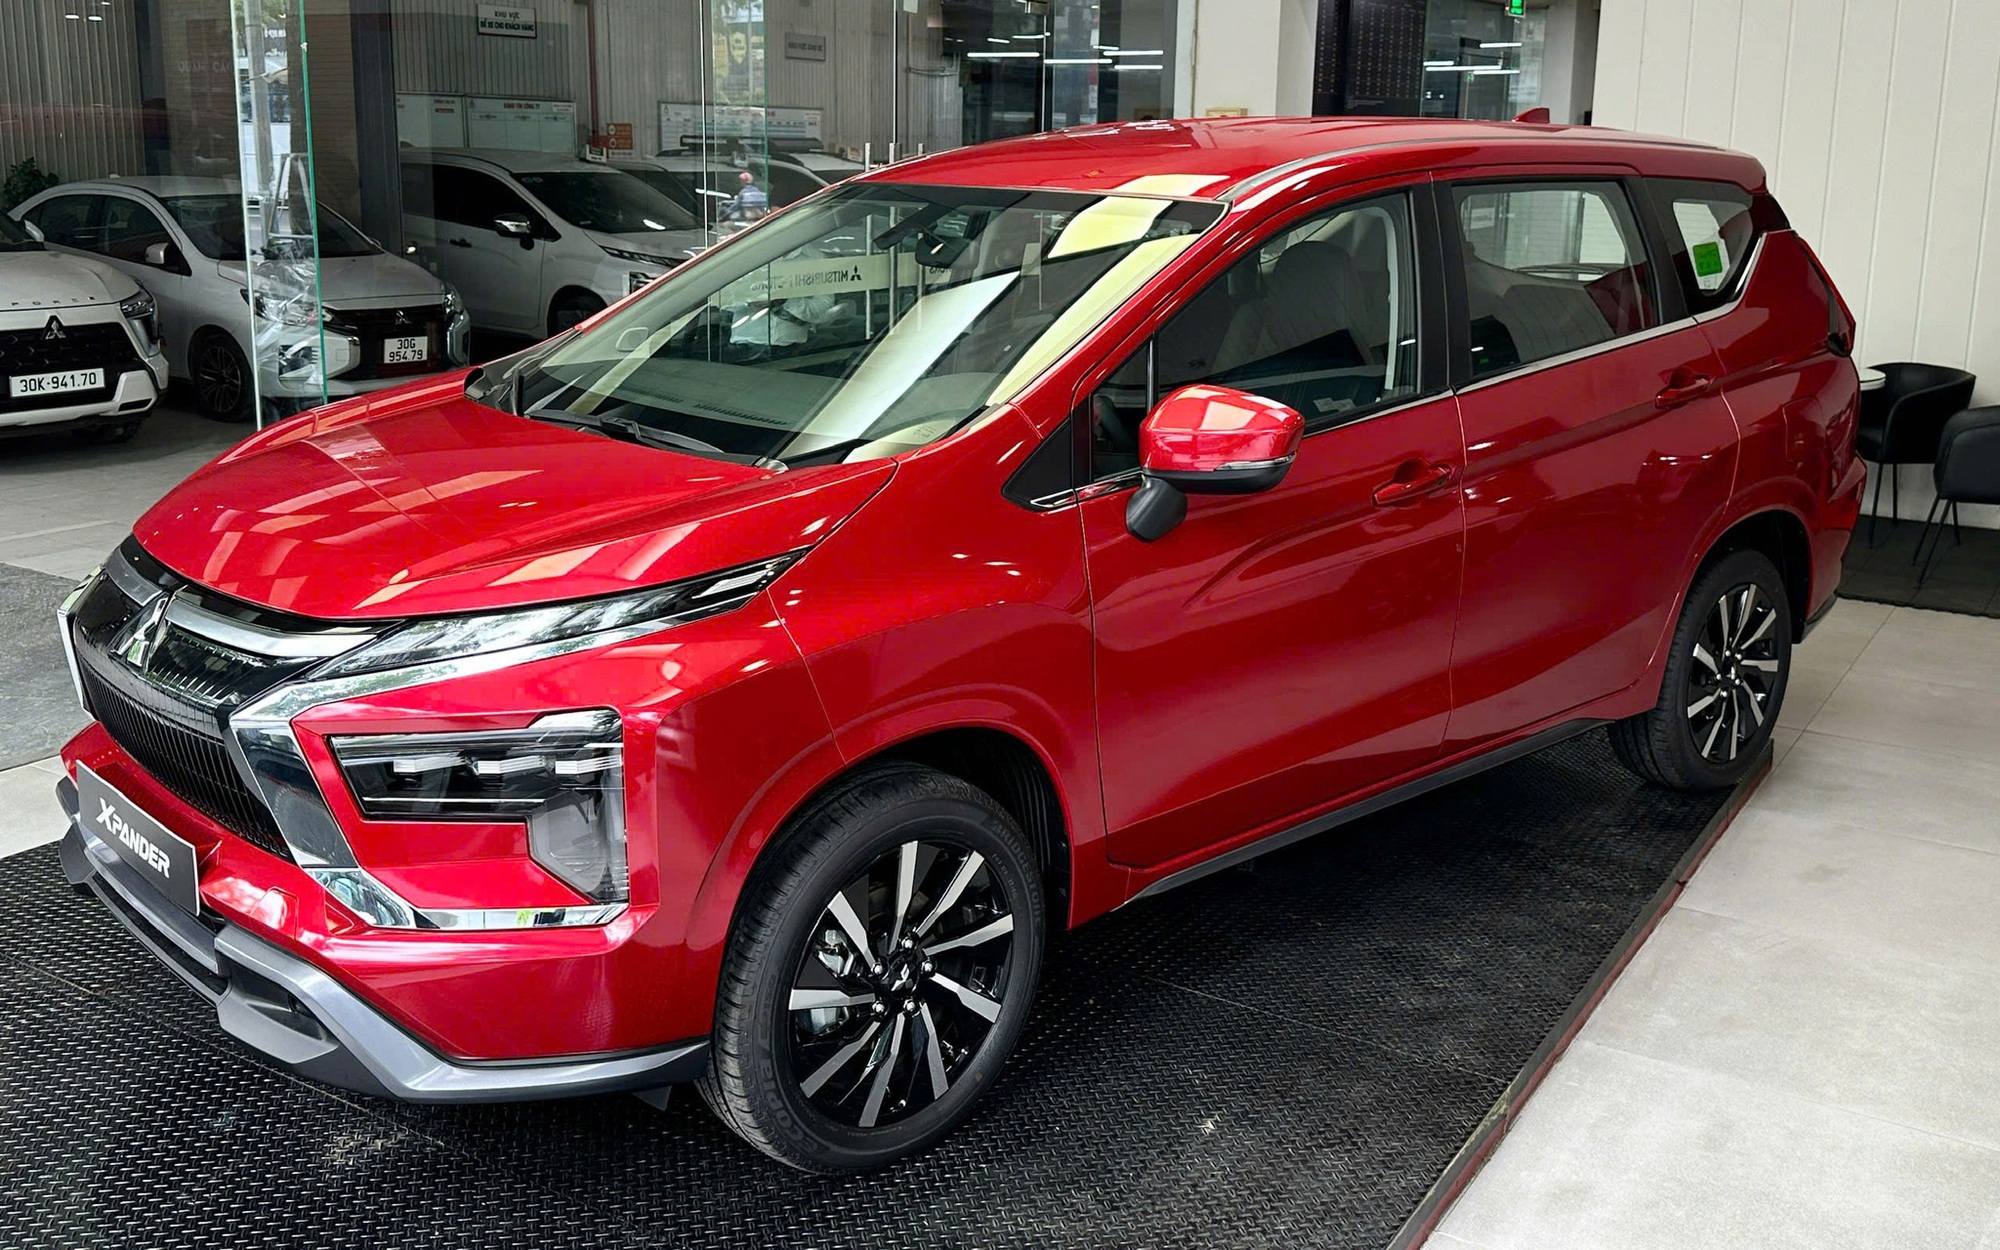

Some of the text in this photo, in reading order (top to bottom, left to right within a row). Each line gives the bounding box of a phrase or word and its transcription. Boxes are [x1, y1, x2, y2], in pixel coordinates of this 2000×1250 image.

[397, 338, 416, 350] 30G
[389, 349, 423, 362] 954.79
[95, 797, 170, 879] XPANDER
